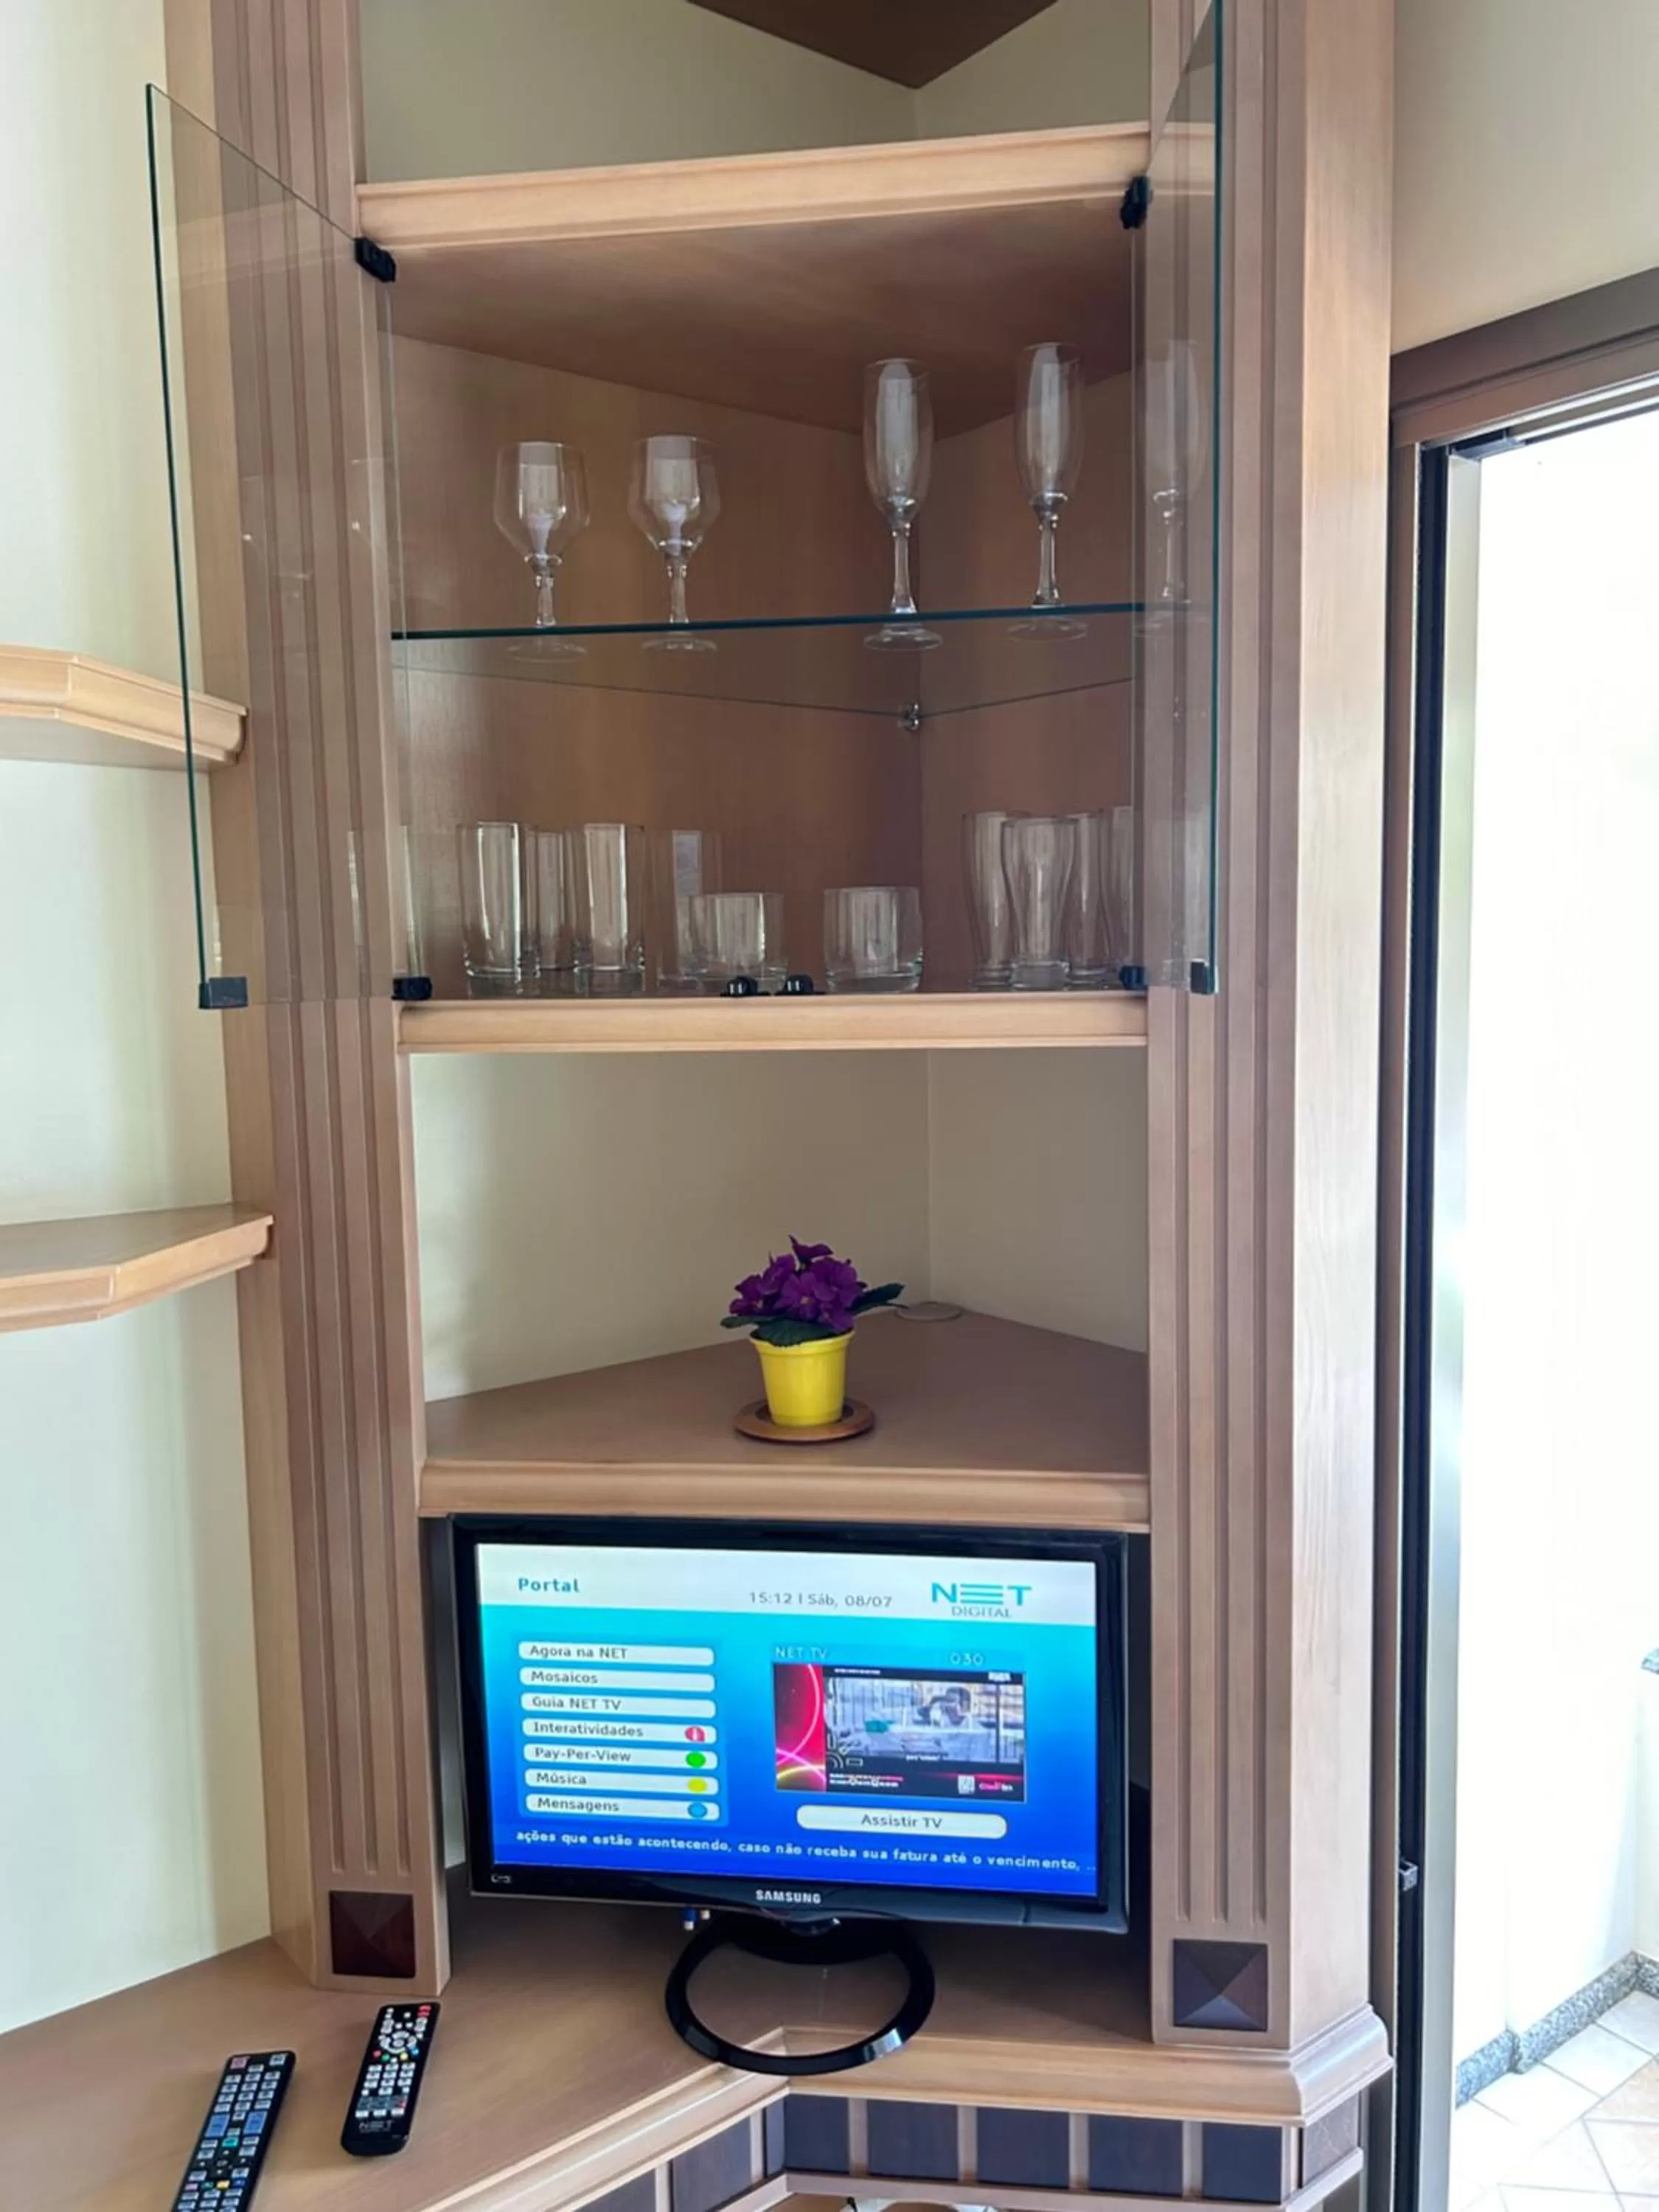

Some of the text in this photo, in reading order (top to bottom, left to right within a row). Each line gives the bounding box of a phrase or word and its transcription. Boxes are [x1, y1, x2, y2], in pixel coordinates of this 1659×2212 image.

[518, 1577, 580, 1593] Portal
[748, 1591, 793, 1605] 15:12
[807, 1593, 839, 1609] Sáb,
[844, 1594, 893, 1608] 08/07
[931, 1582, 1032, 1607] NET
[950, 1605, 1012, 1618] DIGITAL
[529, 1644, 628, 1659] Agora na NET
[775, 1645, 827, 1660] NET TV
[530, 1670, 599, 1684] Mosaicos
[532, 1695, 622, 1711] Guia NET TV
[533, 1721, 644, 1737] Interatividades
[535, 1747, 632, 1762] Pay-Per-View
[535, 1771, 588, 1786] Música
[537, 1797, 620, 1812] Mensagens
[860, 1813, 944, 1829] Assistir TV
[516, 1829, 1080, 1871] ações que estão acontecendo, caso não receba sua fatura até o vencimento,
[754, 1889, 822, 1905] SAMSUNG
